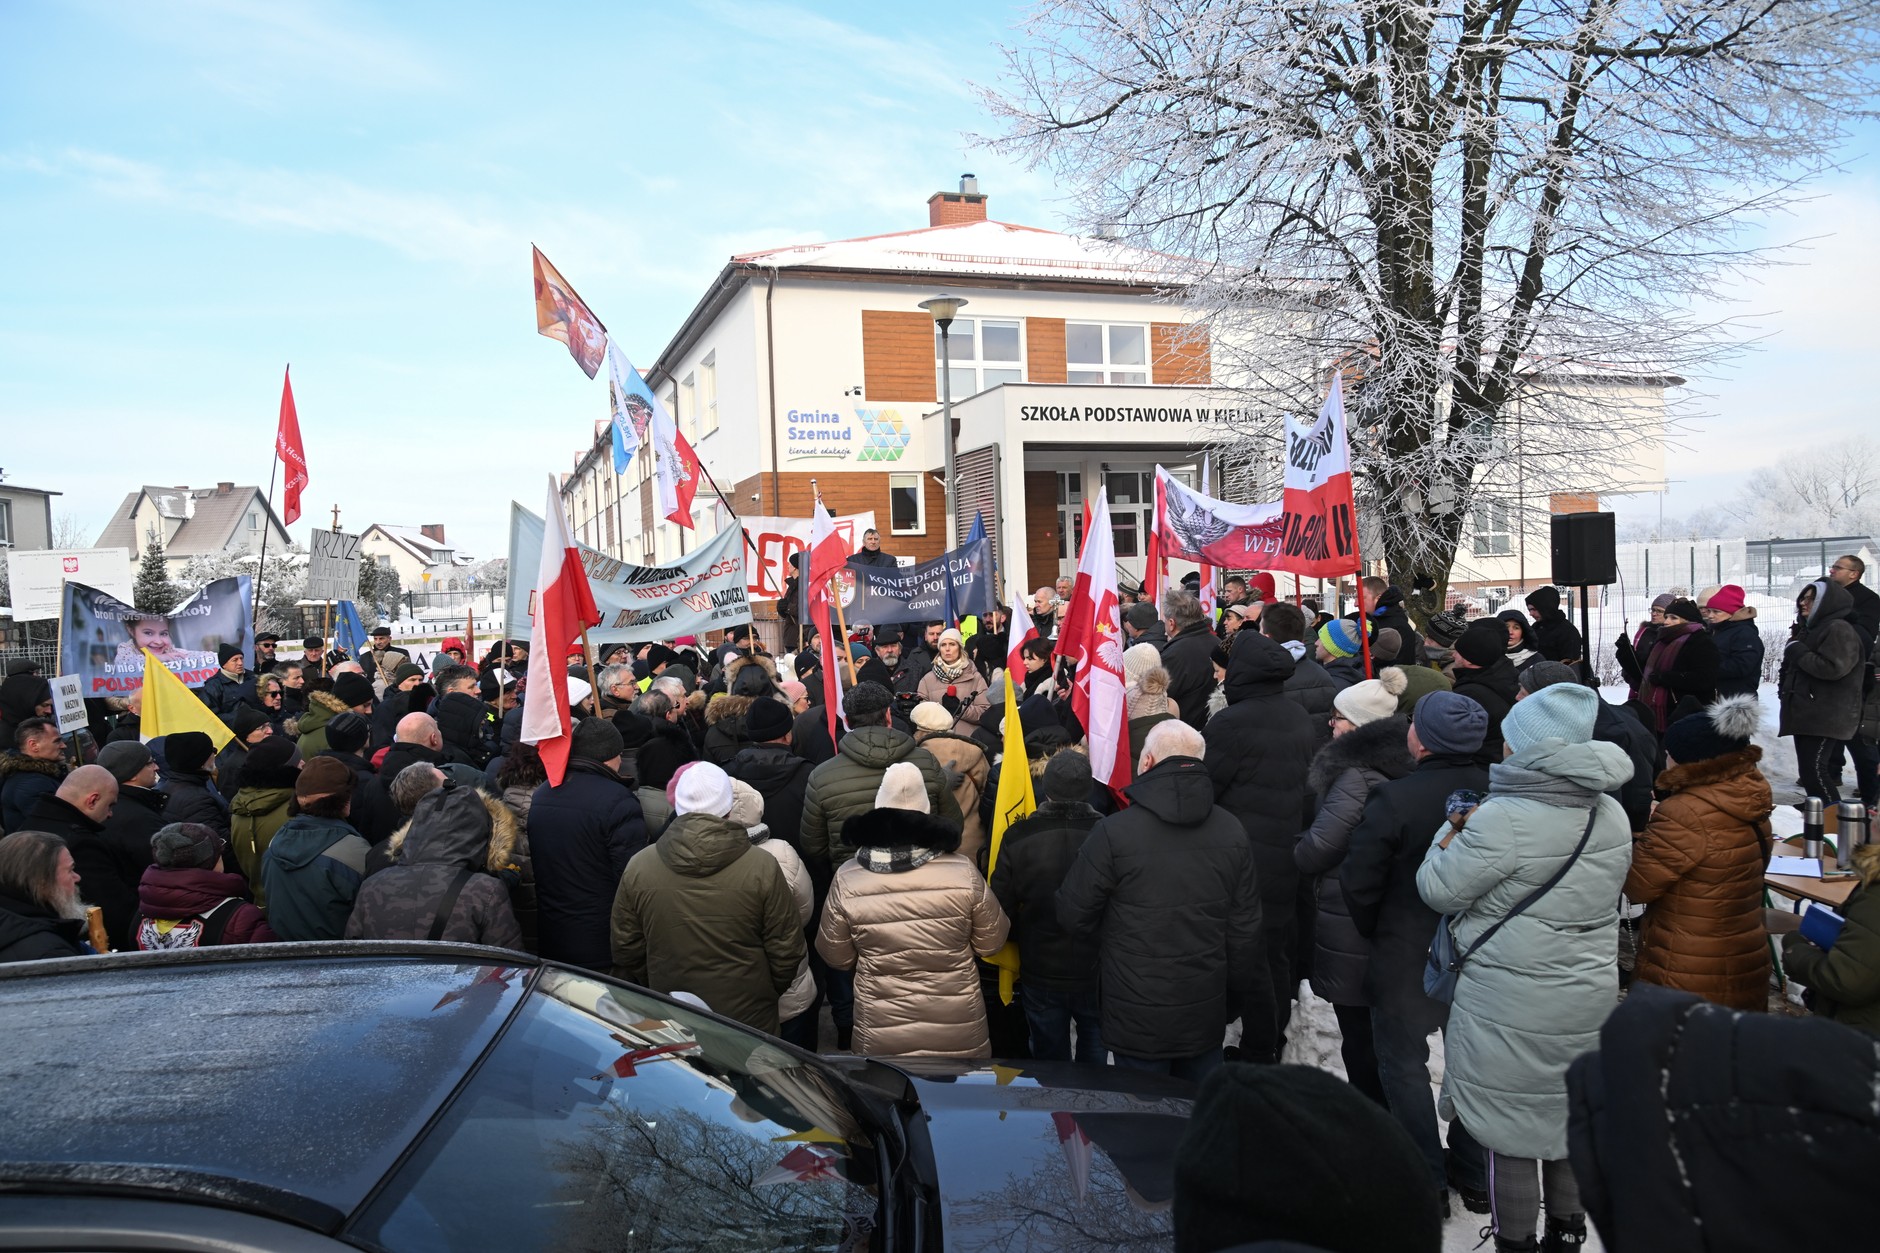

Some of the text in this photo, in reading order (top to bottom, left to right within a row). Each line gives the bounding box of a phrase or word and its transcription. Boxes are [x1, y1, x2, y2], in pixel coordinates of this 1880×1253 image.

[787, 409, 840, 423] Gmina
[1020, 406, 1080, 422] SZKOŁA
[1085, 407, 1192, 423] PODSTAWOWA
[1196, 408, 1210, 423] W
[788, 427, 852, 440] Szemud
[788, 447, 817, 455] kierunek
[868, 557, 971, 587] KONFEDERACJA
[870, 572, 974, 599] KORONY POLKIEJ
[908, 598, 941, 611] GDYNIA
[94, 607, 114, 620] broń
[104, 662, 116, 675] by
[117, 662, 135, 673] nie
